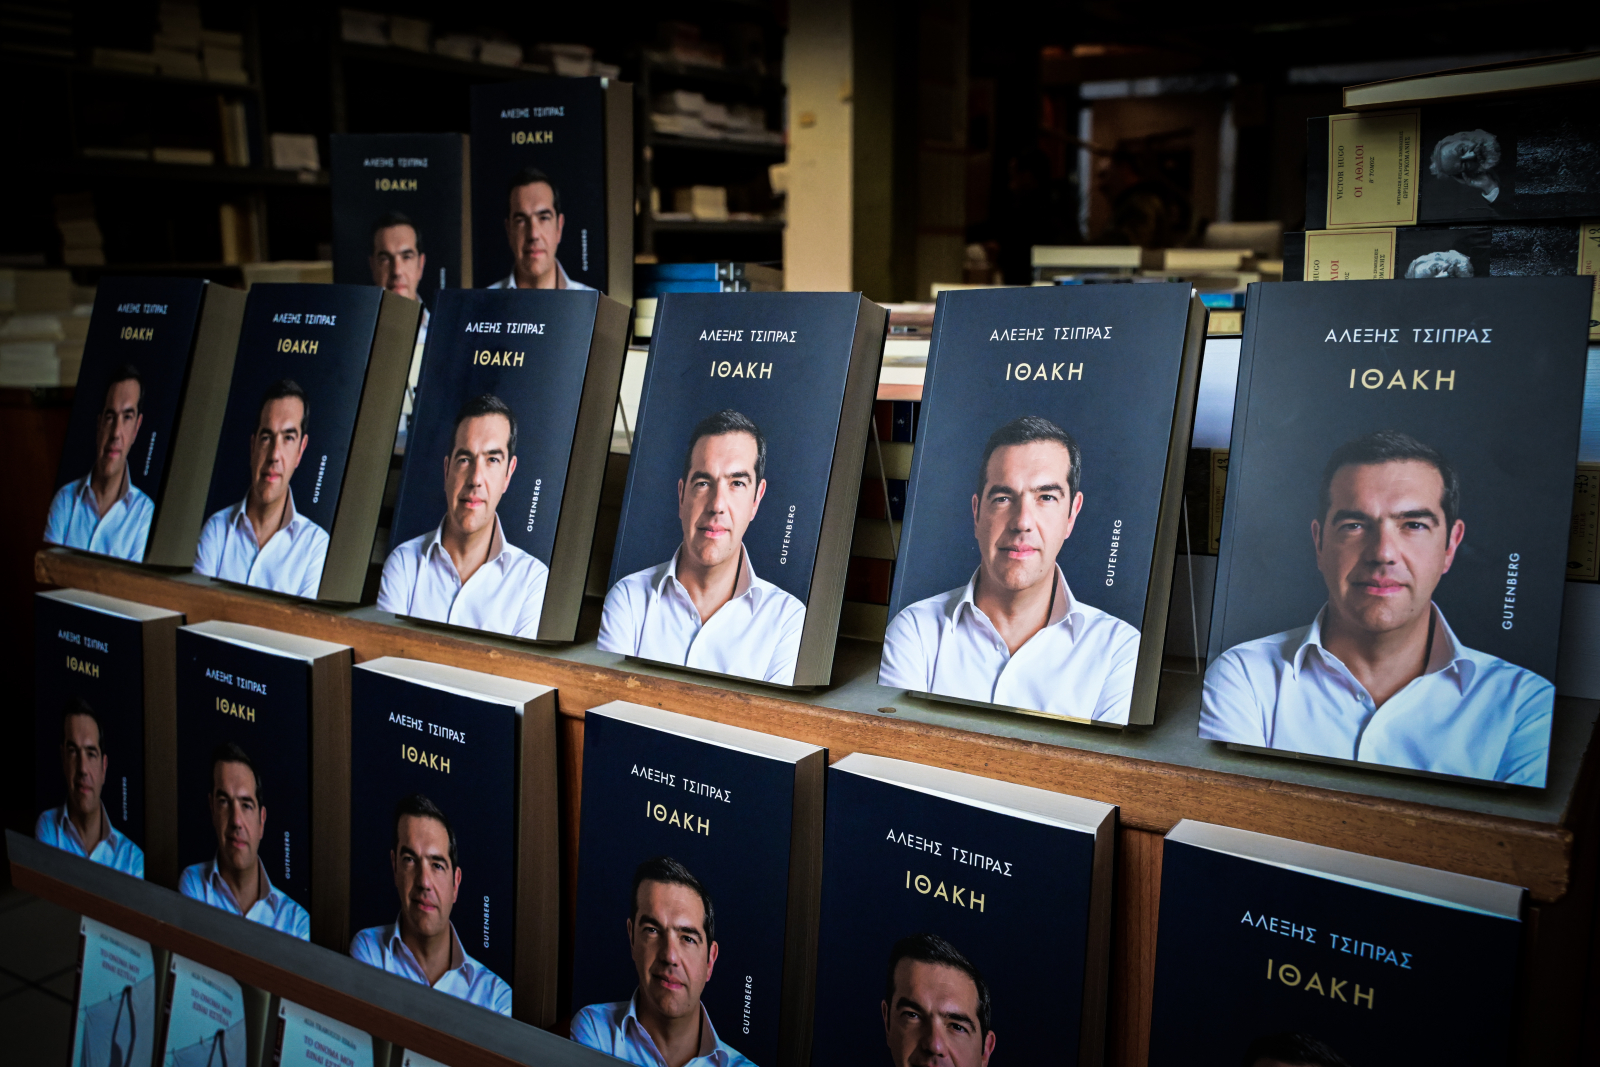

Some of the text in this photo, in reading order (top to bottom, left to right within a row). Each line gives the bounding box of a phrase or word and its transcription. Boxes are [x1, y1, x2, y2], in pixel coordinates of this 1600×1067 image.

[500, 105, 565, 119] ΑΛΕΞΗΣ ΤΣΙΠΡΑΣ
[511, 130, 554, 145] ΙΘΑΚΗ
[375, 178, 418, 191] ΙΘΑΚΗ
[1337, 145, 1345, 199] VICTOR HUGO
[1354, 144, 1364, 198] ΟΙ ΑΘΛΙΟΙ
[117, 302, 169, 315] ΑΛΕΞΗΣ ΤΣΙΠΡΑΣ
[272, 312, 337, 326] ΑΛΕΞΗΣ ΤΣΙΠΡΑΣ
[120, 326, 154, 341] ΙΘΑΚΗ
[465, 321, 546, 335] ΑΛΕΞΗΣ ΤΣΙΠΡΑΣ
[698, 329, 798, 343] ΑΛΕΞΗΣ ΤΣΙΠΡΑΣ
[989, 326, 1113, 342] ΑΛΕΞΗΣ ΤΣΙΠΡΑΣ
[1324, 328, 1492, 343] ΑΛΕΞΗΣ ΤΣΙΠΡΑΣ
[277, 338, 319, 355] ΙΘΑΚΗ
[473, 350, 525, 368] ΙΘΑΚΗ
[710, 360, 773, 380] ΙΘΑΚΗ
[1005, 362, 1084, 381] ΙΘΑΚΗ
[1349, 368, 1456, 391] ΙΘΑΚΗ
[312, 454, 328, 504] GUTENBERG
[526, 478, 542, 533] GUTENBERG
[779, 504, 796, 565] GUTENBERG
[1105, 519, 1123, 587] GUTENBERG
[1501, 552, 1520, 630] GUTENBERG
[57, 629, 109, 654] ΑΛΕΞΗΣ ΤΣΙΠΡΑΣ
[66, 655, 100, 679] ΙΘΑΚΗ
[205, 667, 267, 696] ΑΛΕΞΗΣ ΤΣΙΠΡΑΣ
[215, 696, 256, 723] ΙΘΑΚΗ
[388, 711, 466, 744] ΑΛΕΞΗΣ ΤΣΙΠΡΑΣ
[401, 743, 451, 774] ΙΘΑΚΗ
[630, 763, 732, 804] ΑΛΕΞΗΣ ΤΣΙΠΡΑΣ
[646, 800, 710, 837] ΙΘΑΚΗ
[886, 828, 1013, 877] ΑΛΕΞΗΣ ΤΣΙΠΡΑΣ
[905, 870, 985, 913] ΙΘΑΚΗ
[1240, 910, 1412, 969] ΑΛΕΞΗΣ ΤΣΙΠΡΑΣ
[1266, 958, 1374, 1010] ΙΘΑΚΗ
[742, 975, 753, 1035] GUTENBERG
